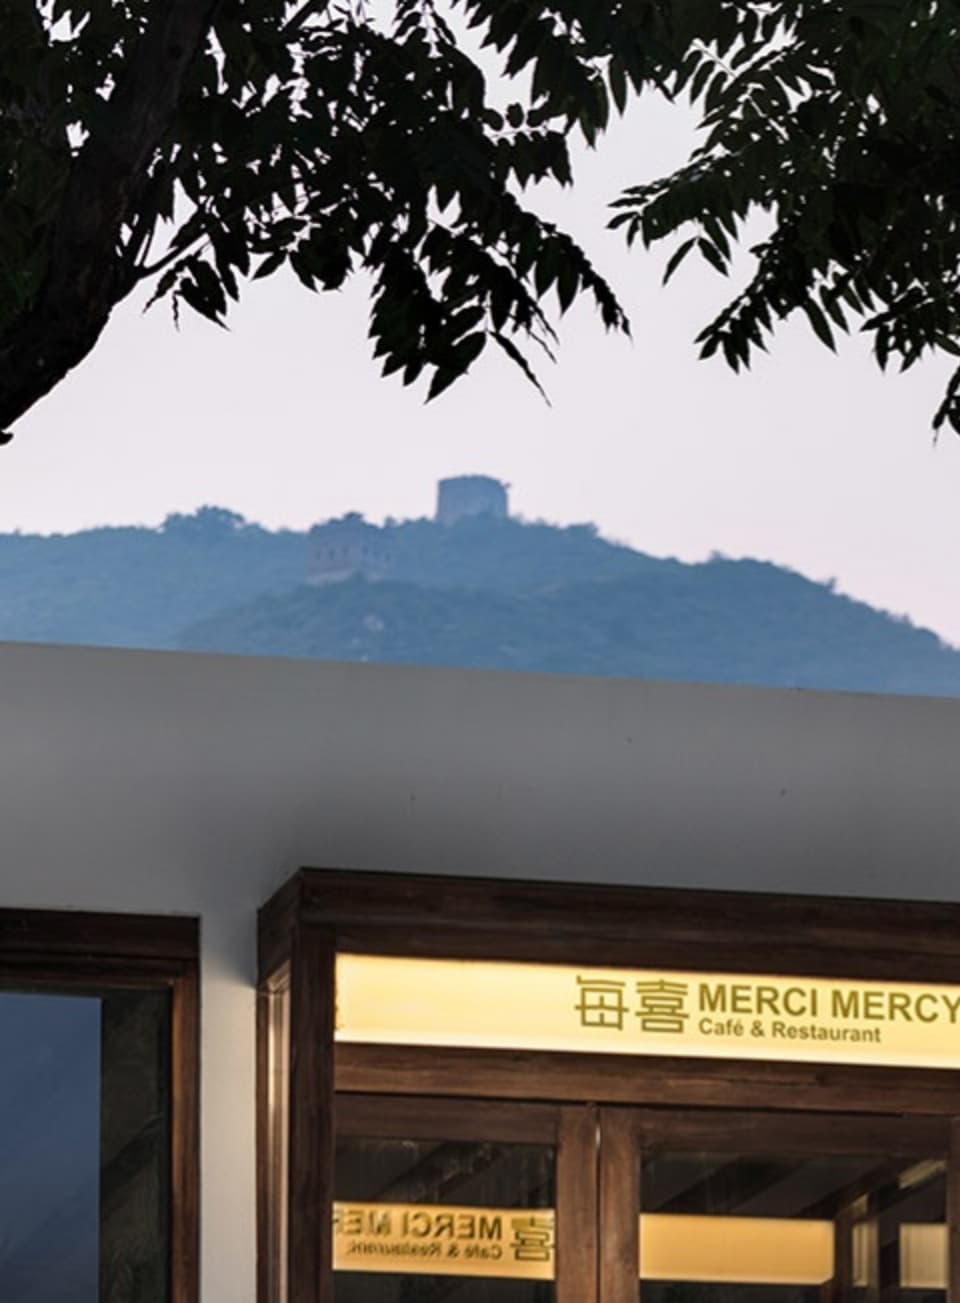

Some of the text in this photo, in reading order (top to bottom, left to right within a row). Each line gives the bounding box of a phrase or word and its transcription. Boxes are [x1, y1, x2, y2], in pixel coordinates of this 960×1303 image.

[699, 982, 818, 1018] MERCI
[699, 1017, 882, 1043] Café & Restaurant
